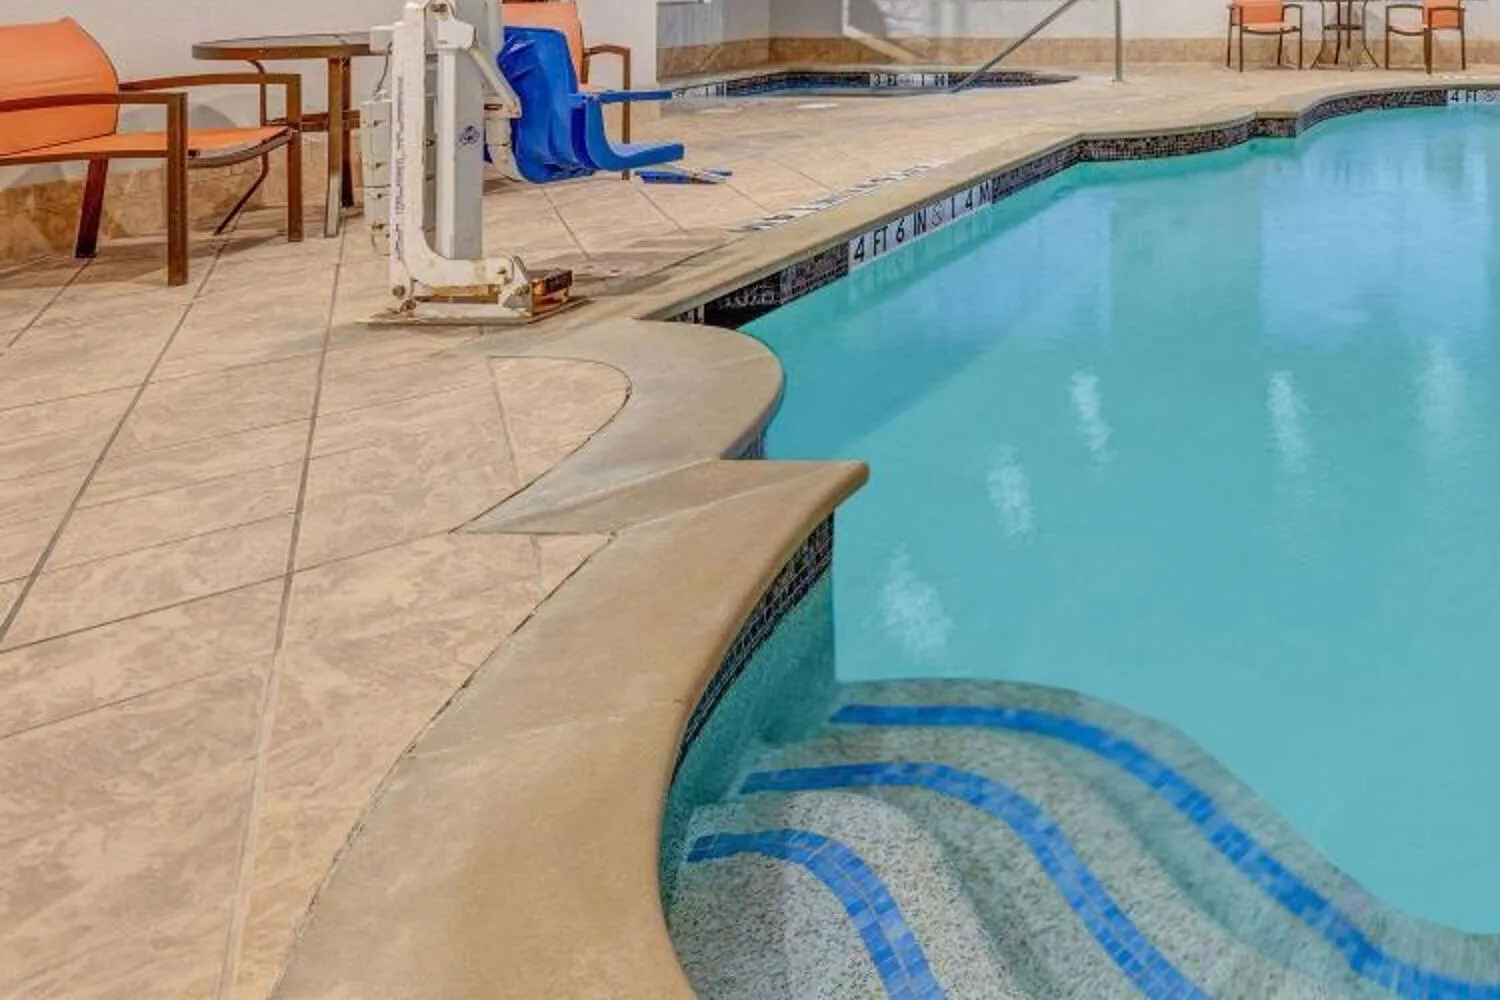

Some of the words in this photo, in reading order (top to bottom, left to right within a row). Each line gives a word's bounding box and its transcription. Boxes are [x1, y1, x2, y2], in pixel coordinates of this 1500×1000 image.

[1450, 91, 1460, 103] 4
[854, 236, 865, 262] 4
[873, 225, 888, 257] FT
[896, 217, 905, 242] 6
[913, 207, 927, 237] IN
[979, 181, 991, 205] M
